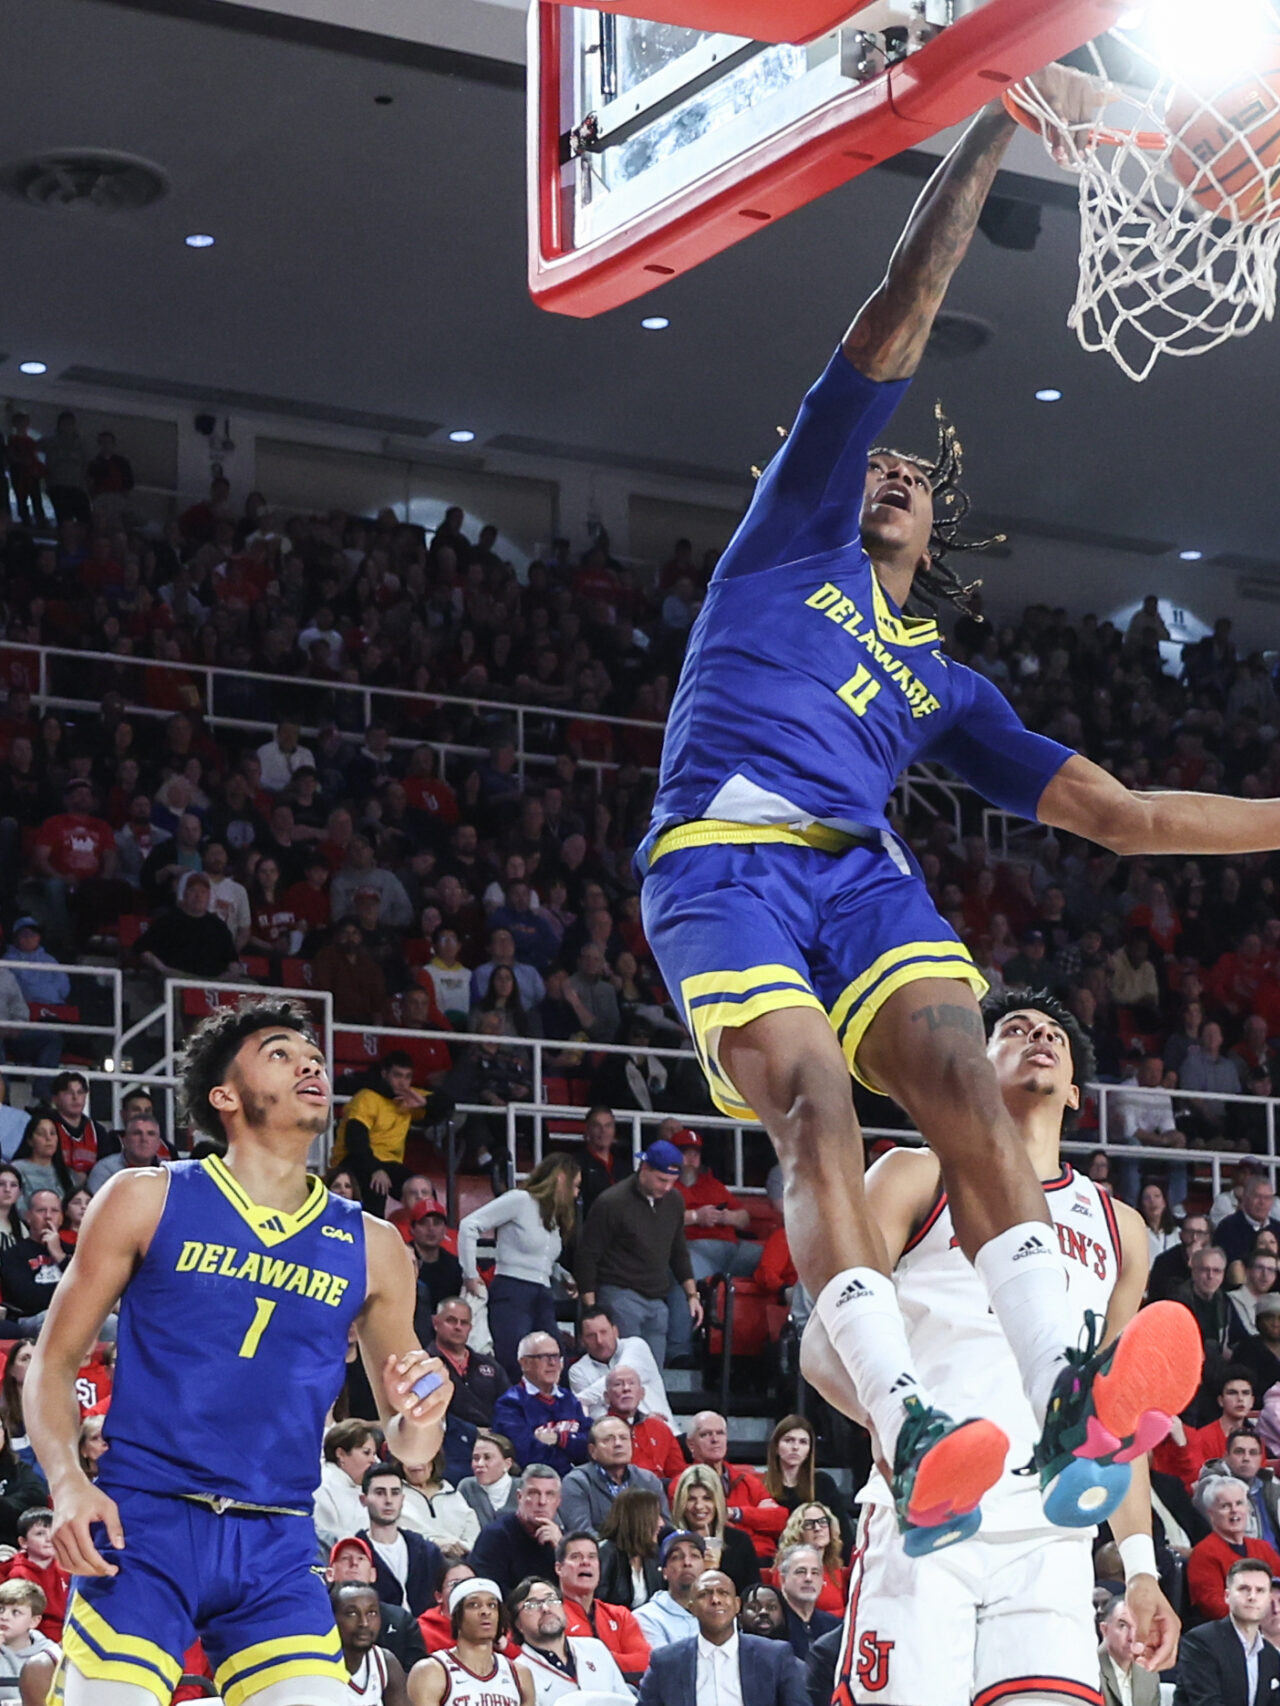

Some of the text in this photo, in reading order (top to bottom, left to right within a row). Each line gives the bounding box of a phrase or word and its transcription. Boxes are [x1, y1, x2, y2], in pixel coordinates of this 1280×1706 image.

[804, 582, 942, 719] DELAWARE
[320, 1224, 354, 1244] CAA
[175, 1240, 350, 1308] DELAWARE
[835, 1288, 875, 1308] adidas
[238, 1296, 278, 1359] 1
